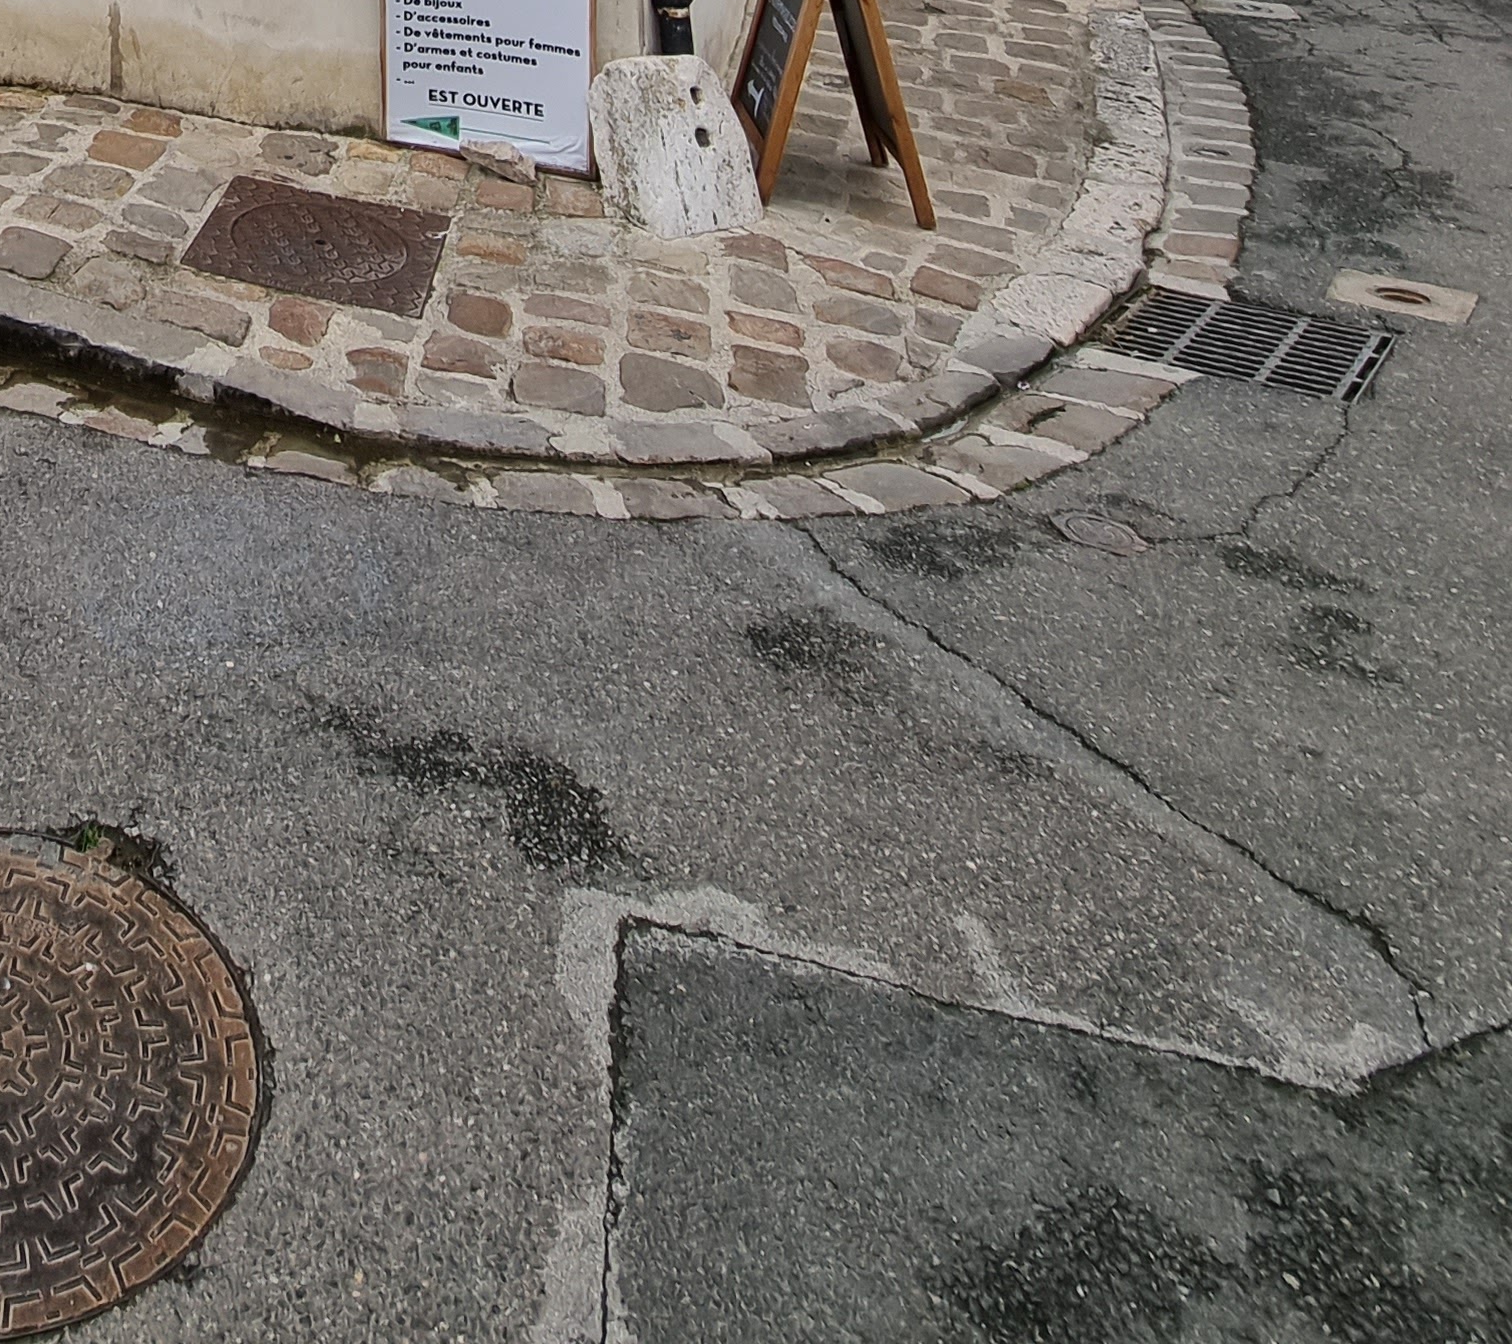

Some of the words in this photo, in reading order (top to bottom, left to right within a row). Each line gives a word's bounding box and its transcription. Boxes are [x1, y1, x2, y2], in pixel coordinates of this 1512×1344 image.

[403, 10, 491, 28] D'accessoires
[403, 26, 421, 38] De
[424, 28, 492, 44] vêtements
[495, 36, 526, 48] pour
[528, 38, 581, 57] femmes
[403, 42, 456, 56] D'armes
[459, 47, 473, 58] et
[476, 51, 538, 66] costumes
[402, 59, 432, 72] pour
[434, 60, 484, 75] enfants
[428, 88, 459, 104] EST
[462, 93, 545, 118] OUVERTE
